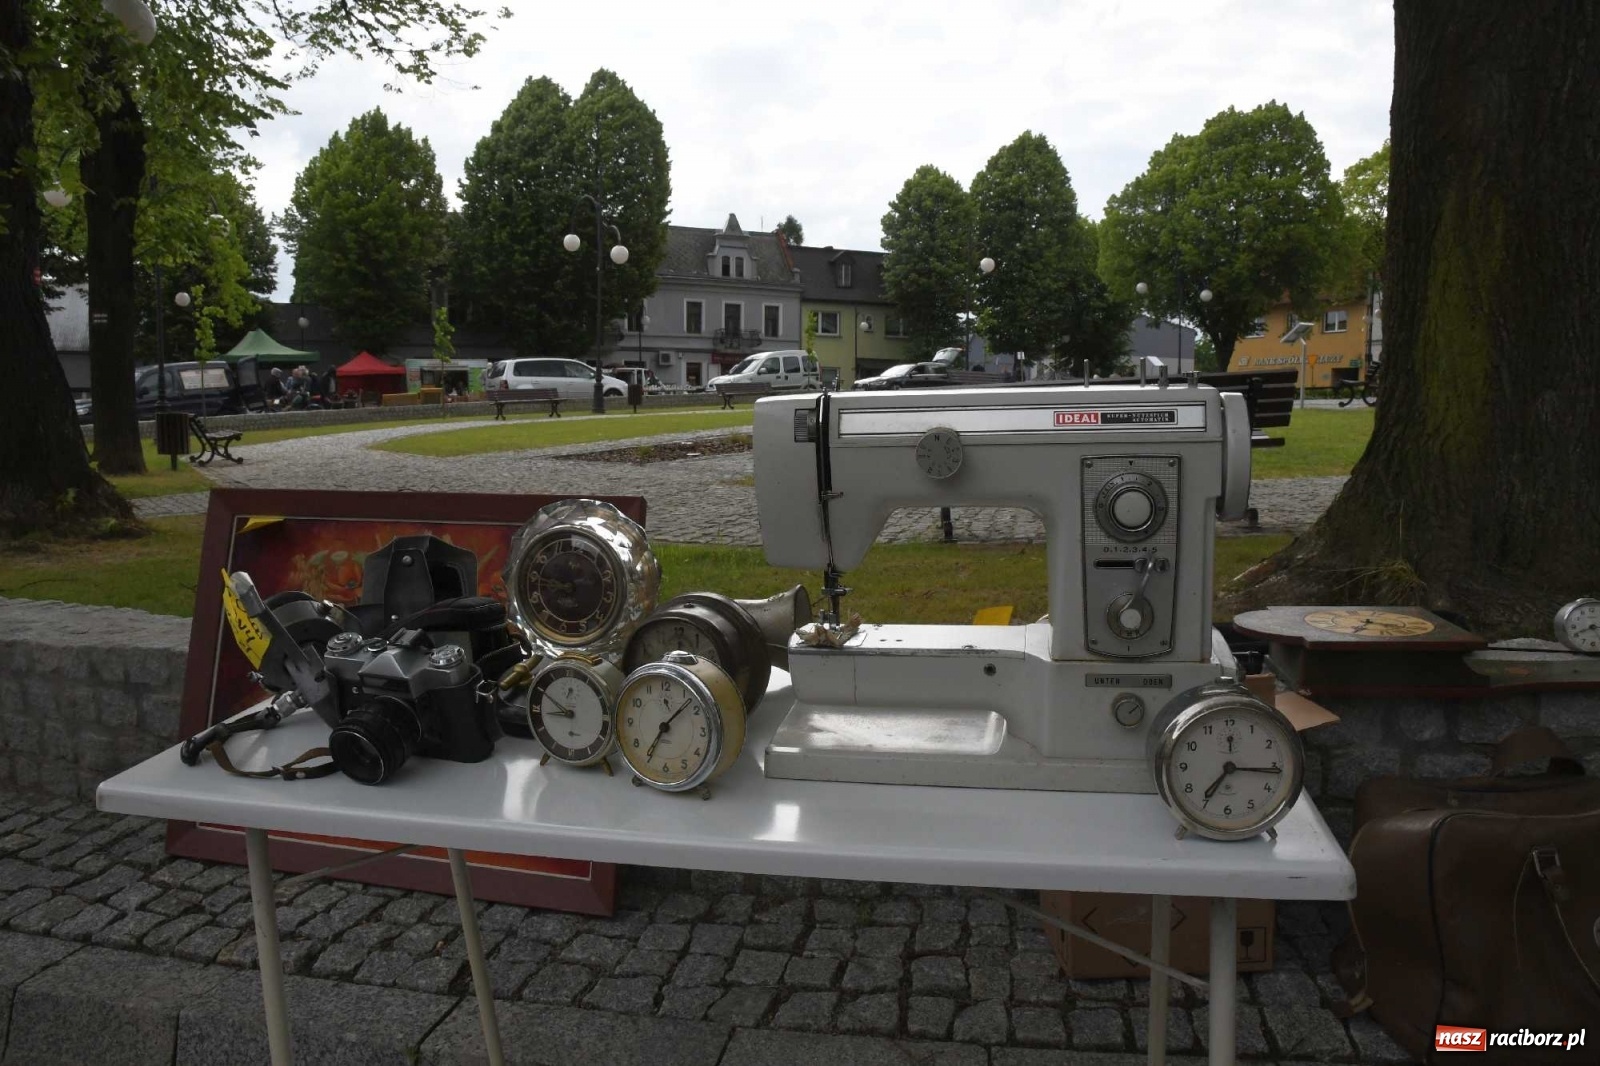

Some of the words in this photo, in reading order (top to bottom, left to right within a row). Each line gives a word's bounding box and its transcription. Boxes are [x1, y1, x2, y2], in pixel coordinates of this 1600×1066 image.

[1254, 356, 1276, 367] BANK
[1059, 413, 1097, 424] IDEAL
[646, 685, 652, 695] 11
[661, 681, 671, 692] 12
[683, 689, 686, 698] 1
[632, 698, 642, 708] 10
[693, 705, 701, 716] 2
[627, 717, 634, 727] 9
[700, 727, 706, 738] 3
[1202, 725, 1213, 735] 11
[1249, 725, 1254, 734] 1
[633, 738, 640, 748] 8
[1187, 741, 1197, 752] 10
[1265, 739, 1273, 749] 2
[693, 747, 701, 757] 4
[662, 762, 670, 773] 6
[681, 759, 688, 770] 5
[1179, 762, 1188, 772] 9
[1184, 783, 1194, 793] 8
[1264, 783, 1272, 793] 4
[1202, 798, 1210, 809] 7
[1247, 799, 1255, 809] 5
[1223, 805, 1232, 815] 6
